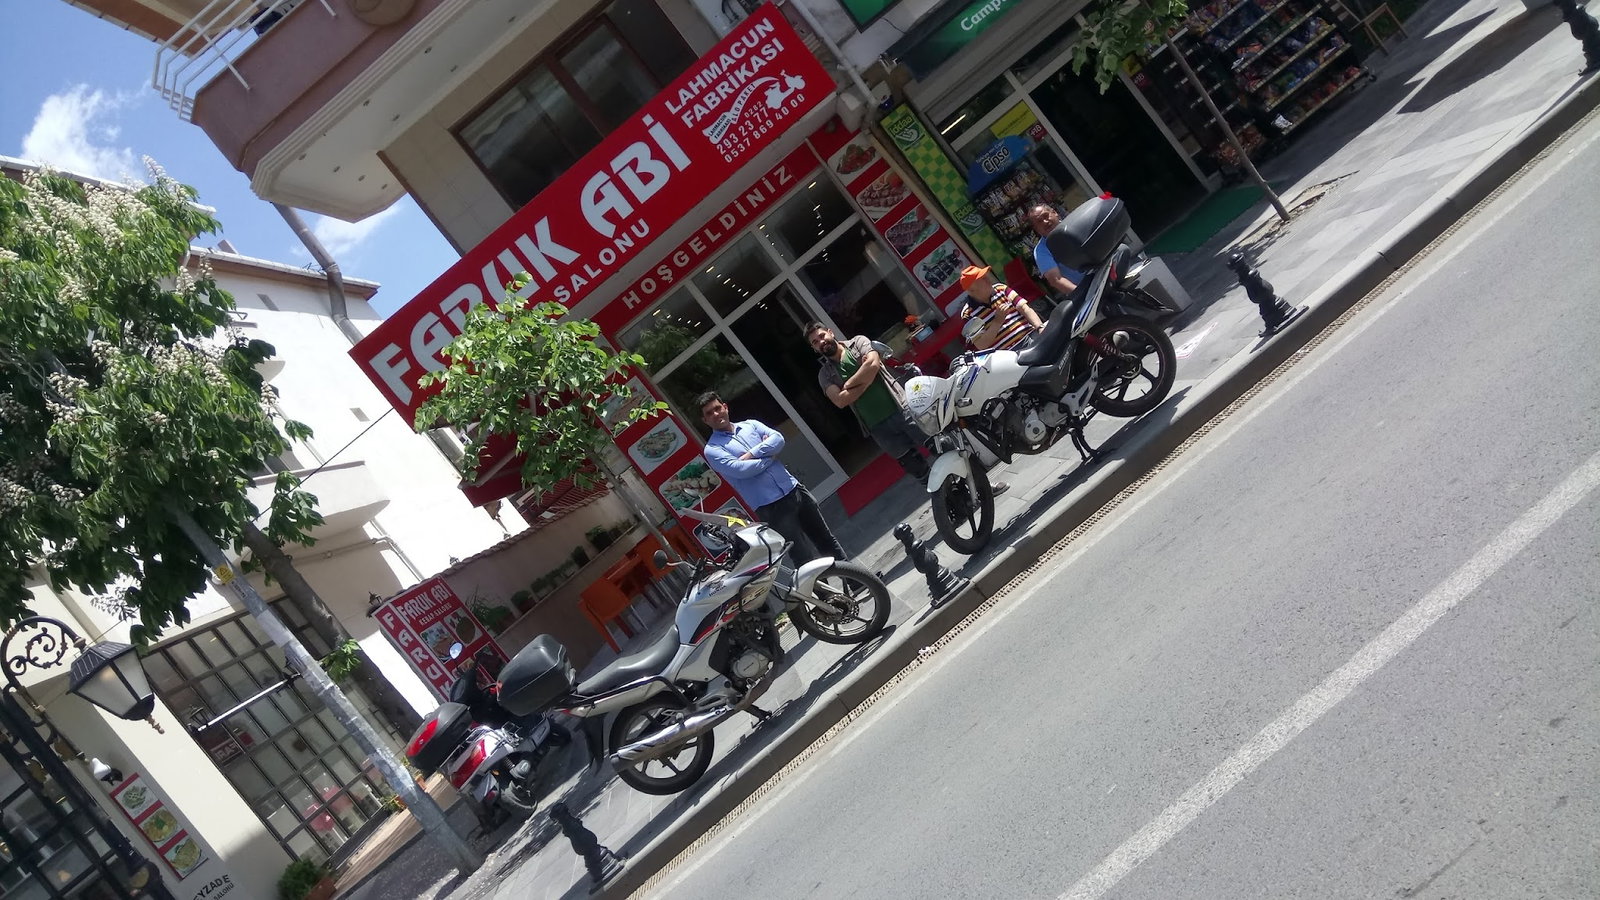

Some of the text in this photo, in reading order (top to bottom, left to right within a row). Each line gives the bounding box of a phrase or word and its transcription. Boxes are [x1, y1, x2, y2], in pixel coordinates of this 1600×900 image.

[960, 0, 1006, 30] Camp
[664, 17, 775, 113] LAHMACUN
[680, 37, 785, 128] FABRİKASI
[738, 83, 756, 107] PAKET
[744, 101, 763, 118] 0282
[716, 106, 769, 155] 293 23 77
[724, 93, 805, 163] 0537 869 40 00
[981, 145, 1011, 175] Cipso
[368, 113, 692, 406] FARUK ABİ
[553, 217, 651, 304] SALONU
[621, 165, 793, 310] HOŞGELDİNİZ
[396, 592, 436, 625] FARUK
